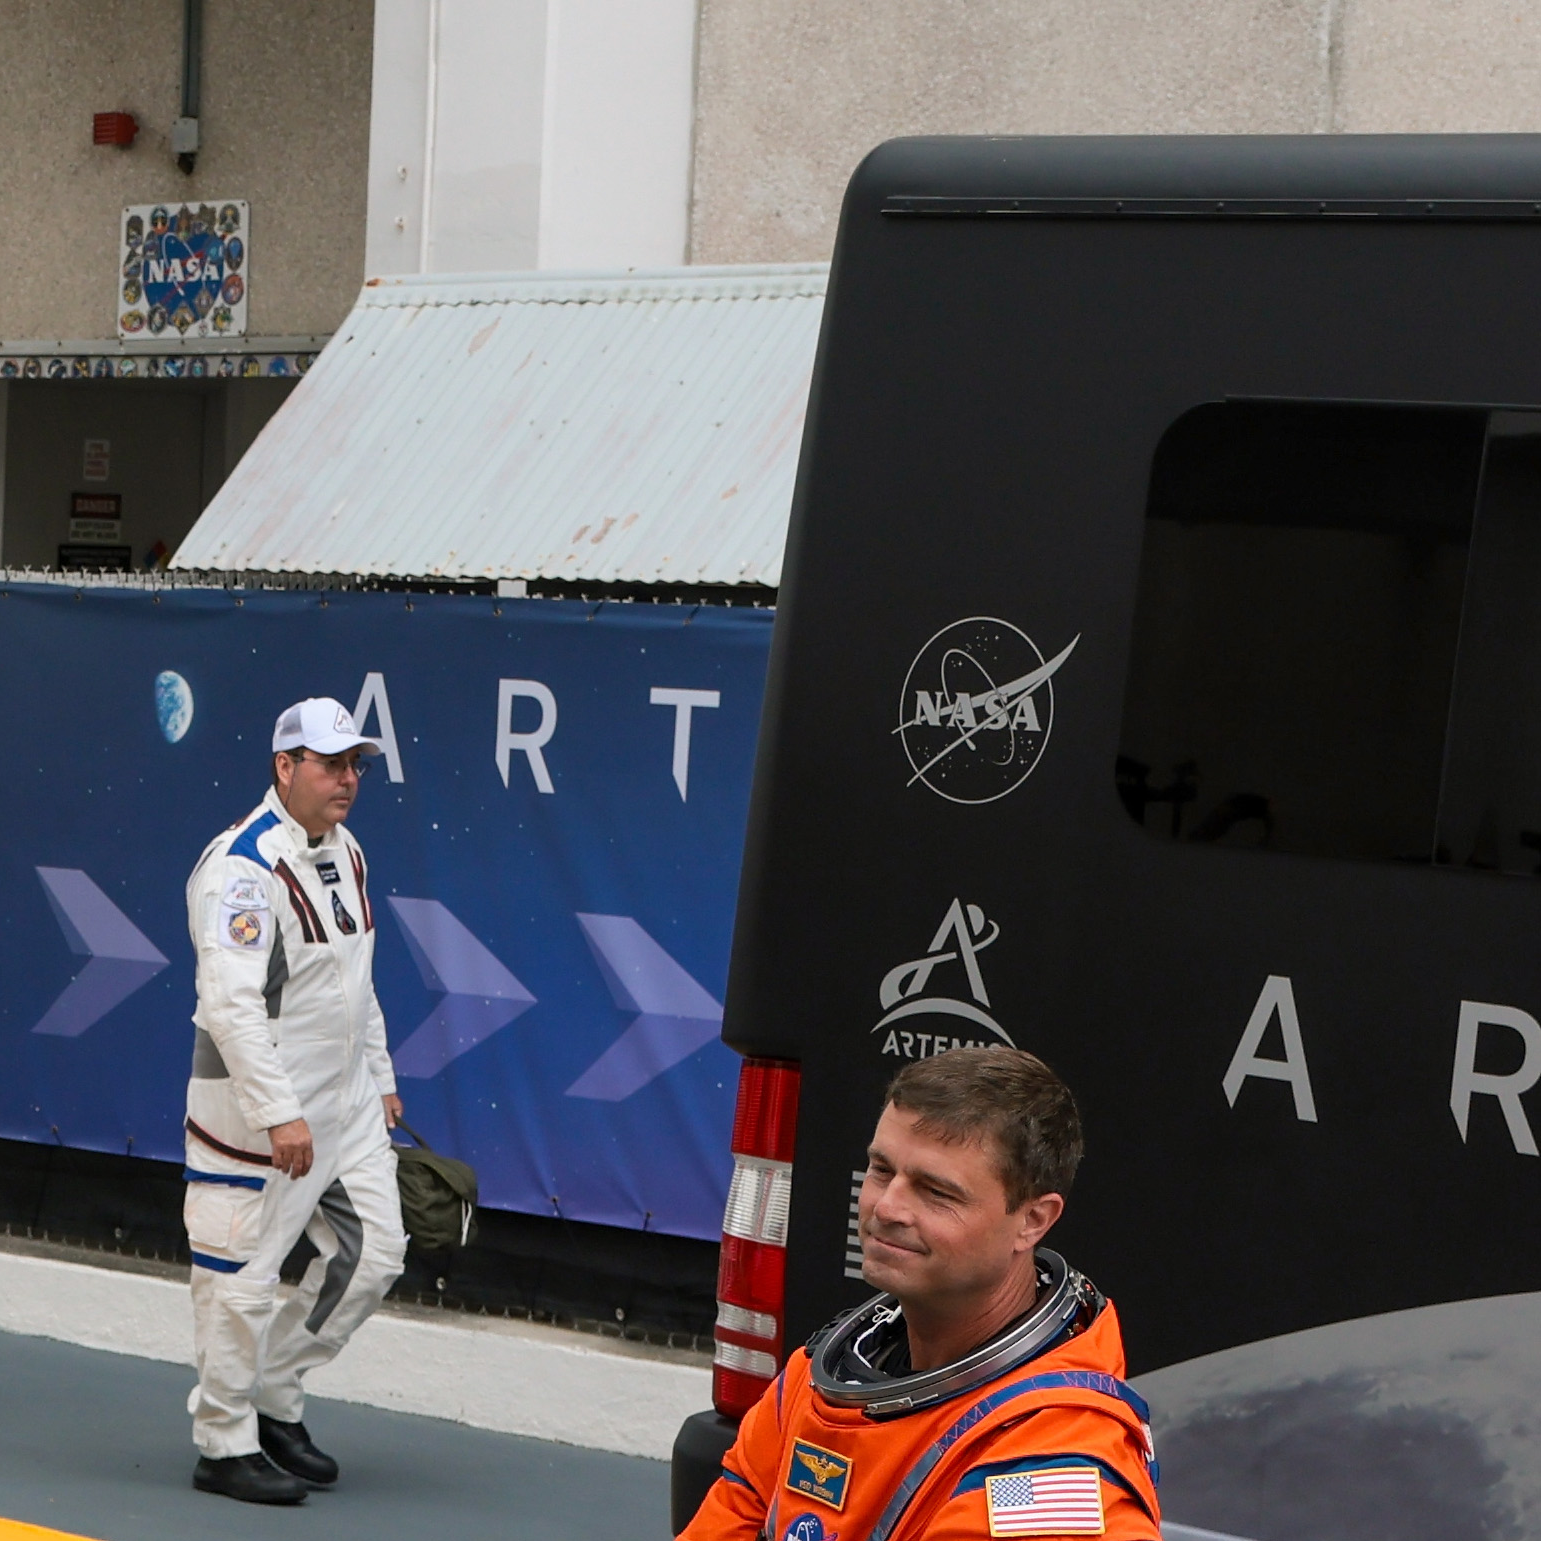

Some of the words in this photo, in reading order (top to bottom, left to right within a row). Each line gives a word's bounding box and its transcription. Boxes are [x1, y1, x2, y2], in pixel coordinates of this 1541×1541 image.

[148, 257, 220, 284] NASA
[913, 689, 1043, 733] NASA
[881, 1029, 1003, 1060] ARTE
